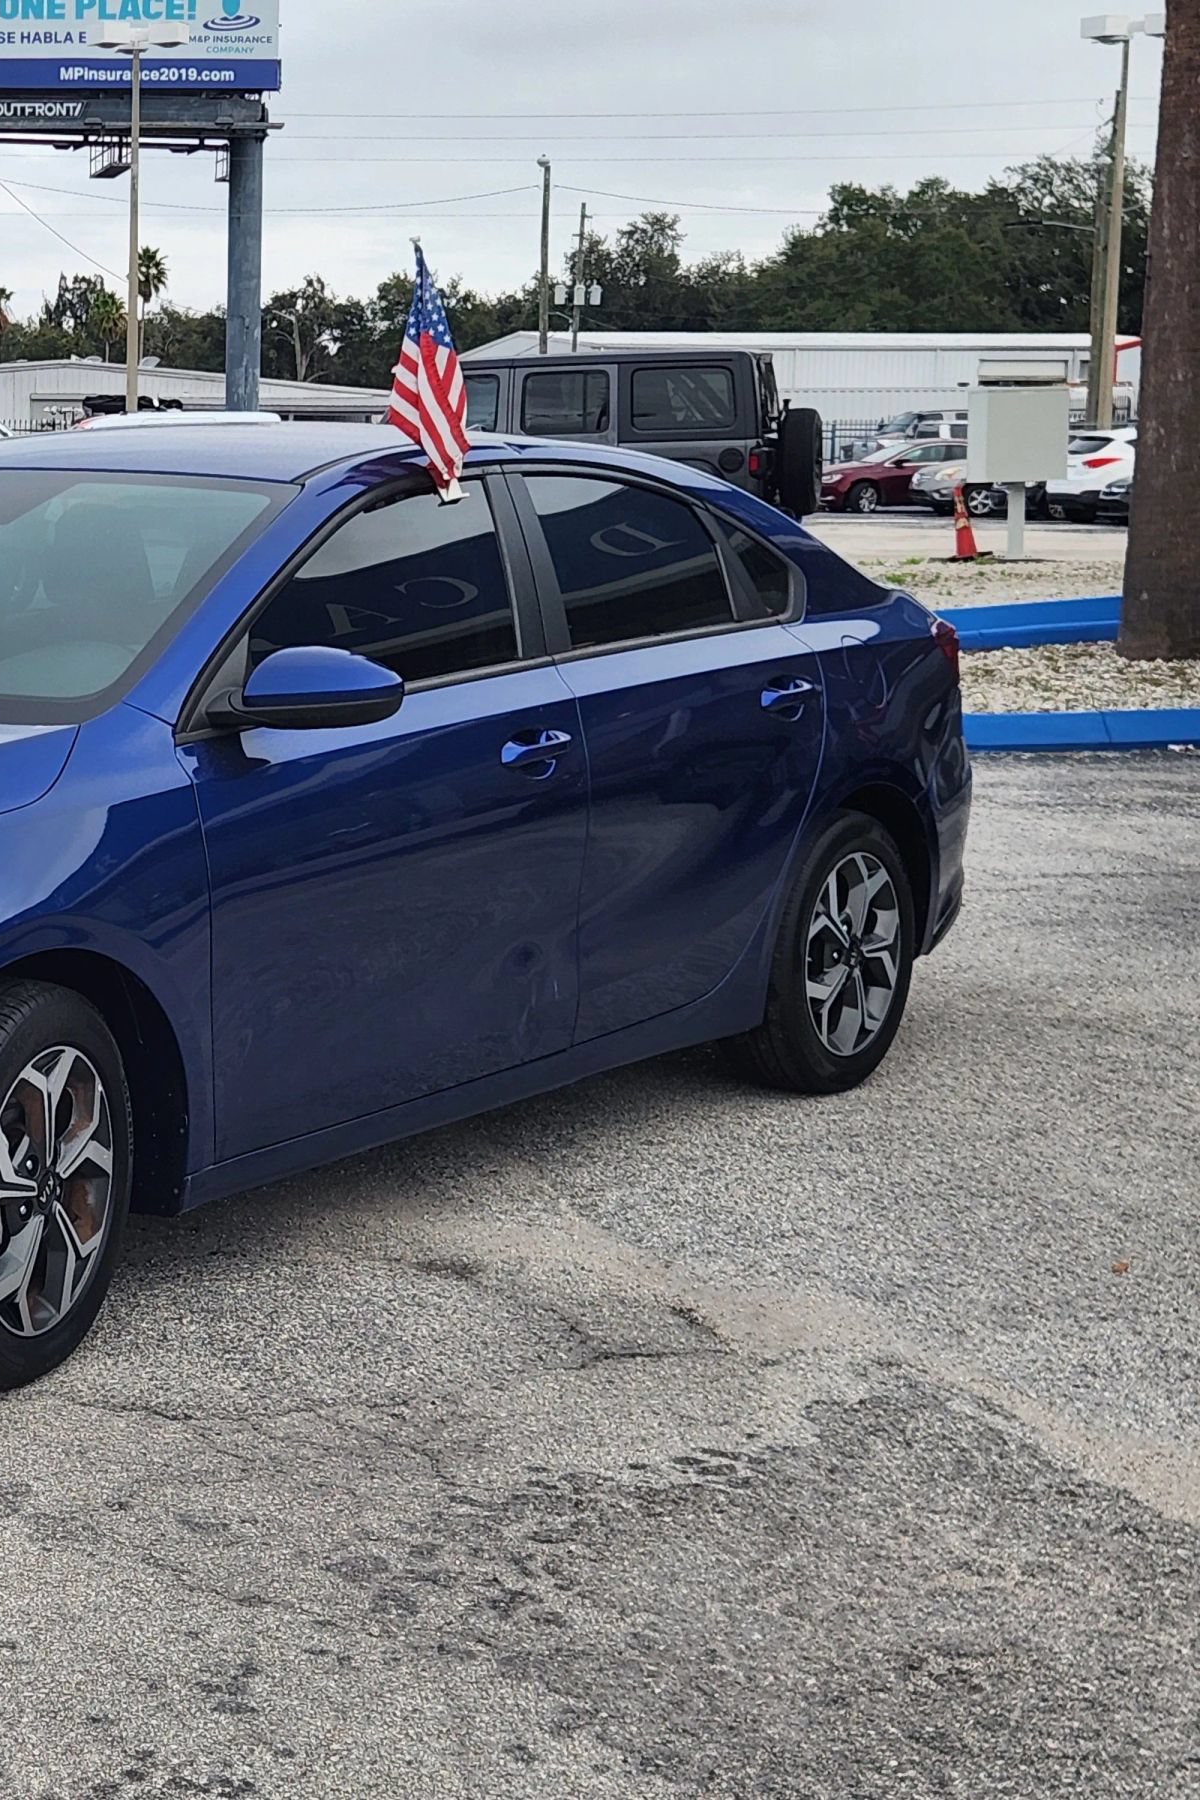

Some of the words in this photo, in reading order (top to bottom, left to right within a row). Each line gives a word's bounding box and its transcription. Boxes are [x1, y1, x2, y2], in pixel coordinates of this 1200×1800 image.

[75, 0, 197, 20] PLACE!
[20, 31, 74, 44] HABLA
[188, 35, 211, 44] M&P
[213, 35, 273, 44] INSURANCE
[206, 46, 255, 54] COMPANY
[59, 67, 235, 82] MPInsurace2019.com
